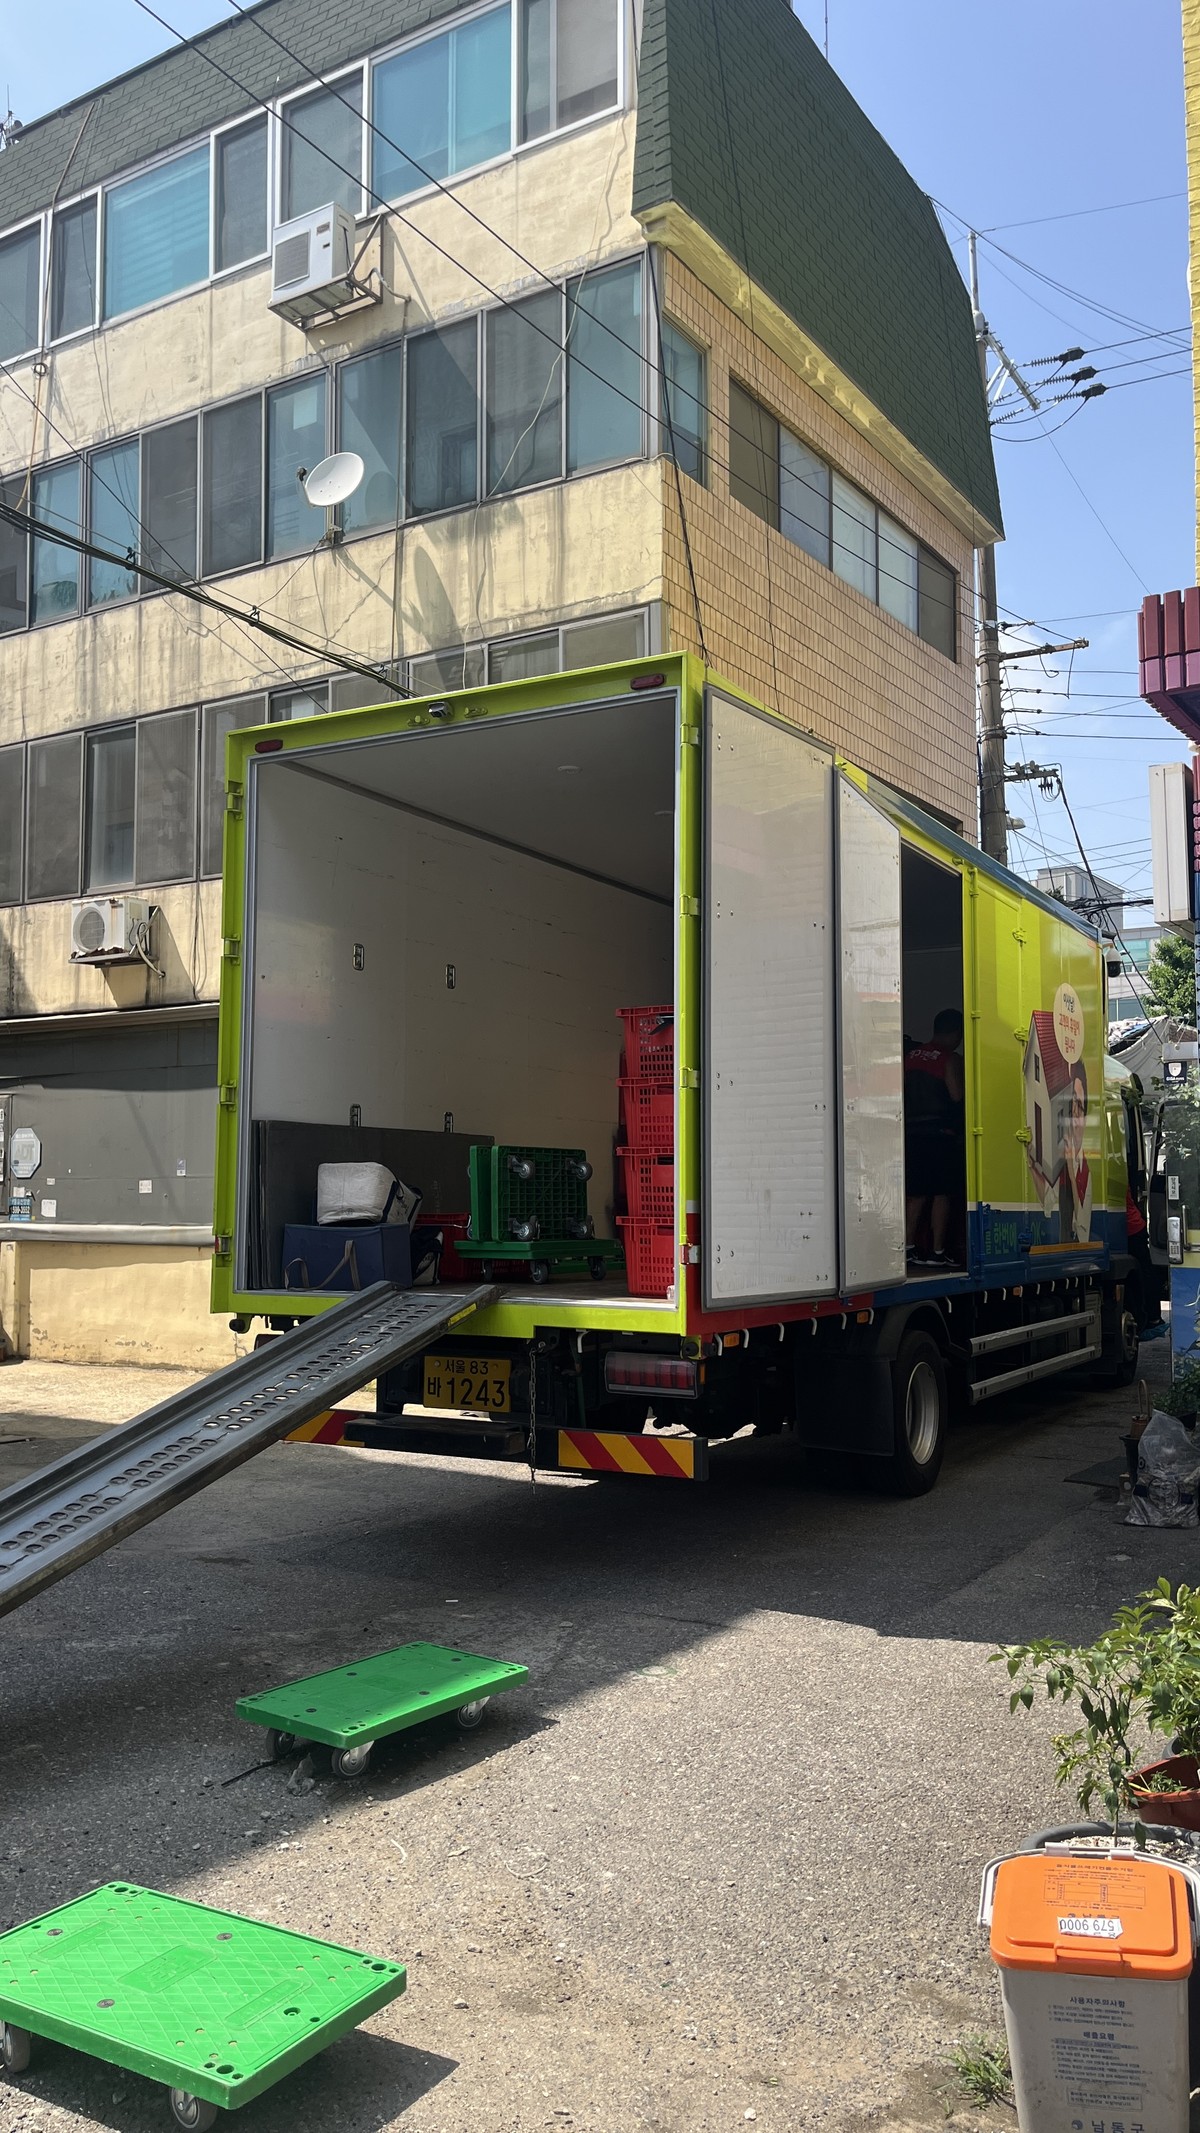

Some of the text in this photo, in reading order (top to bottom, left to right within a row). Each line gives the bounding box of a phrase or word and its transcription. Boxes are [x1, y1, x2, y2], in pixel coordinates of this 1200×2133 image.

[994, 1222, 1017, 1254] 한번에
[445, 1360, 489, 1375] 서울 83
[427, 1377, 505, 1407] 바 1243
[1059, 1919, 1115, 1932] 579 9000
[1070, 1996, 1126, 2009] 사용자주의사항
[1083, 2031, 1115, 2041] 배출요령
